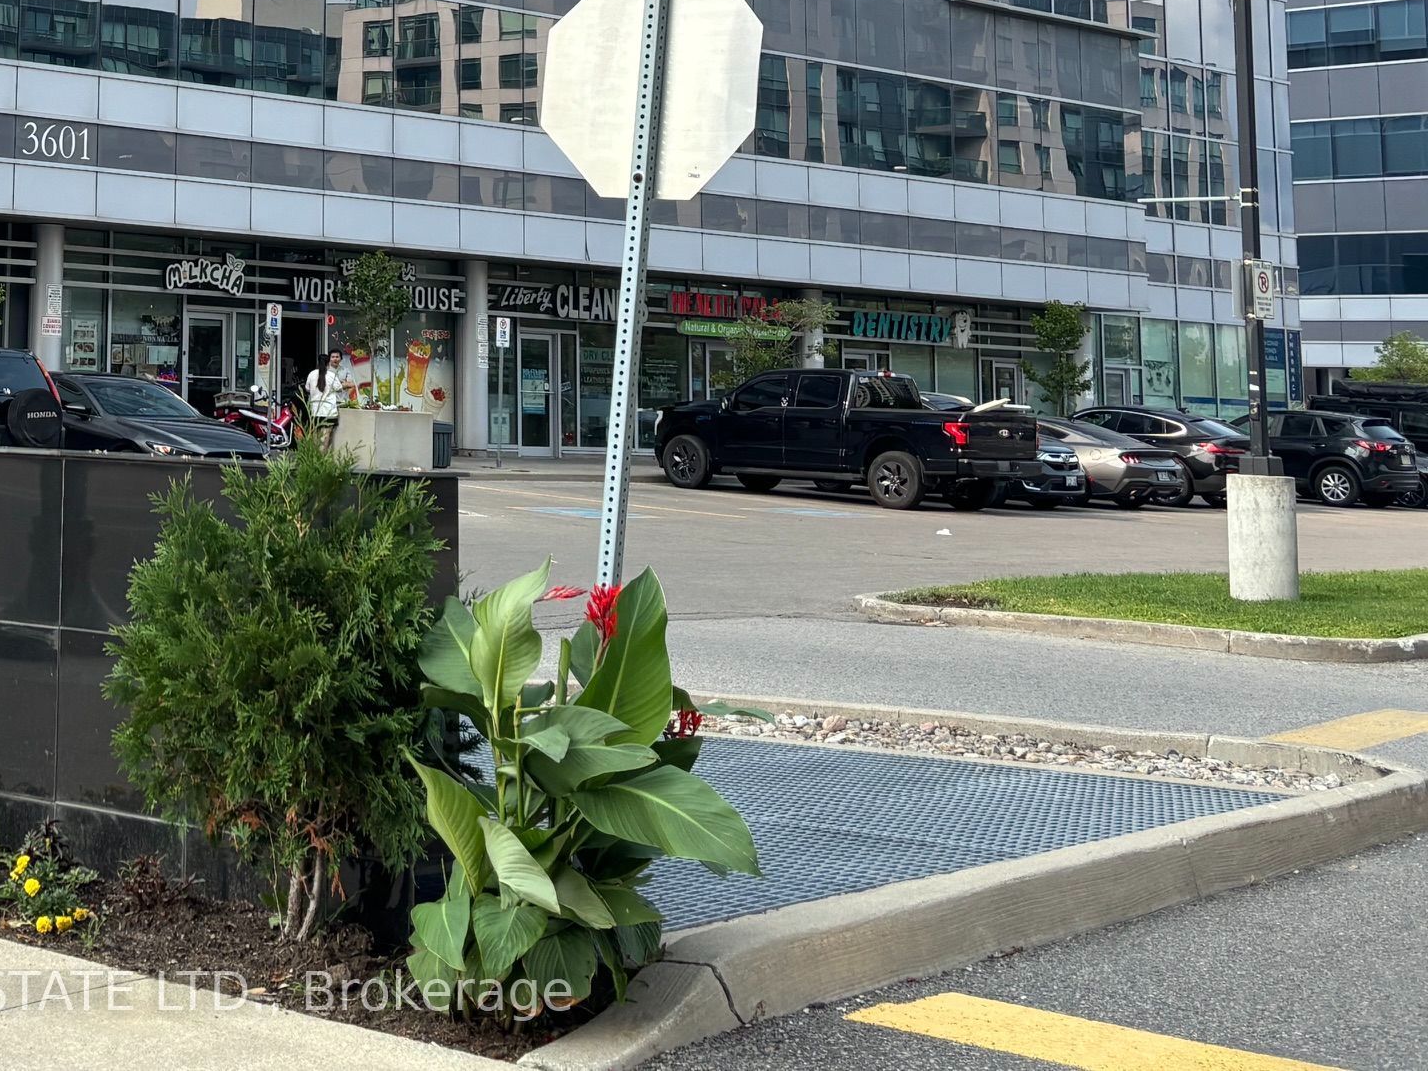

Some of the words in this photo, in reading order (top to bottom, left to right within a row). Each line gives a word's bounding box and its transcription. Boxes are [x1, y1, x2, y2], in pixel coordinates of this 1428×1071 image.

[22, 122, 90, 161] 3601
[500, 286, 553, 312] Liberty
[556, 284, 648, 323] CLEAN
[672, 291, 735, 318] HEALTH
[853, 311, 952, 343] DENTISTRY
[27, 411, 58, 419] HONDA
